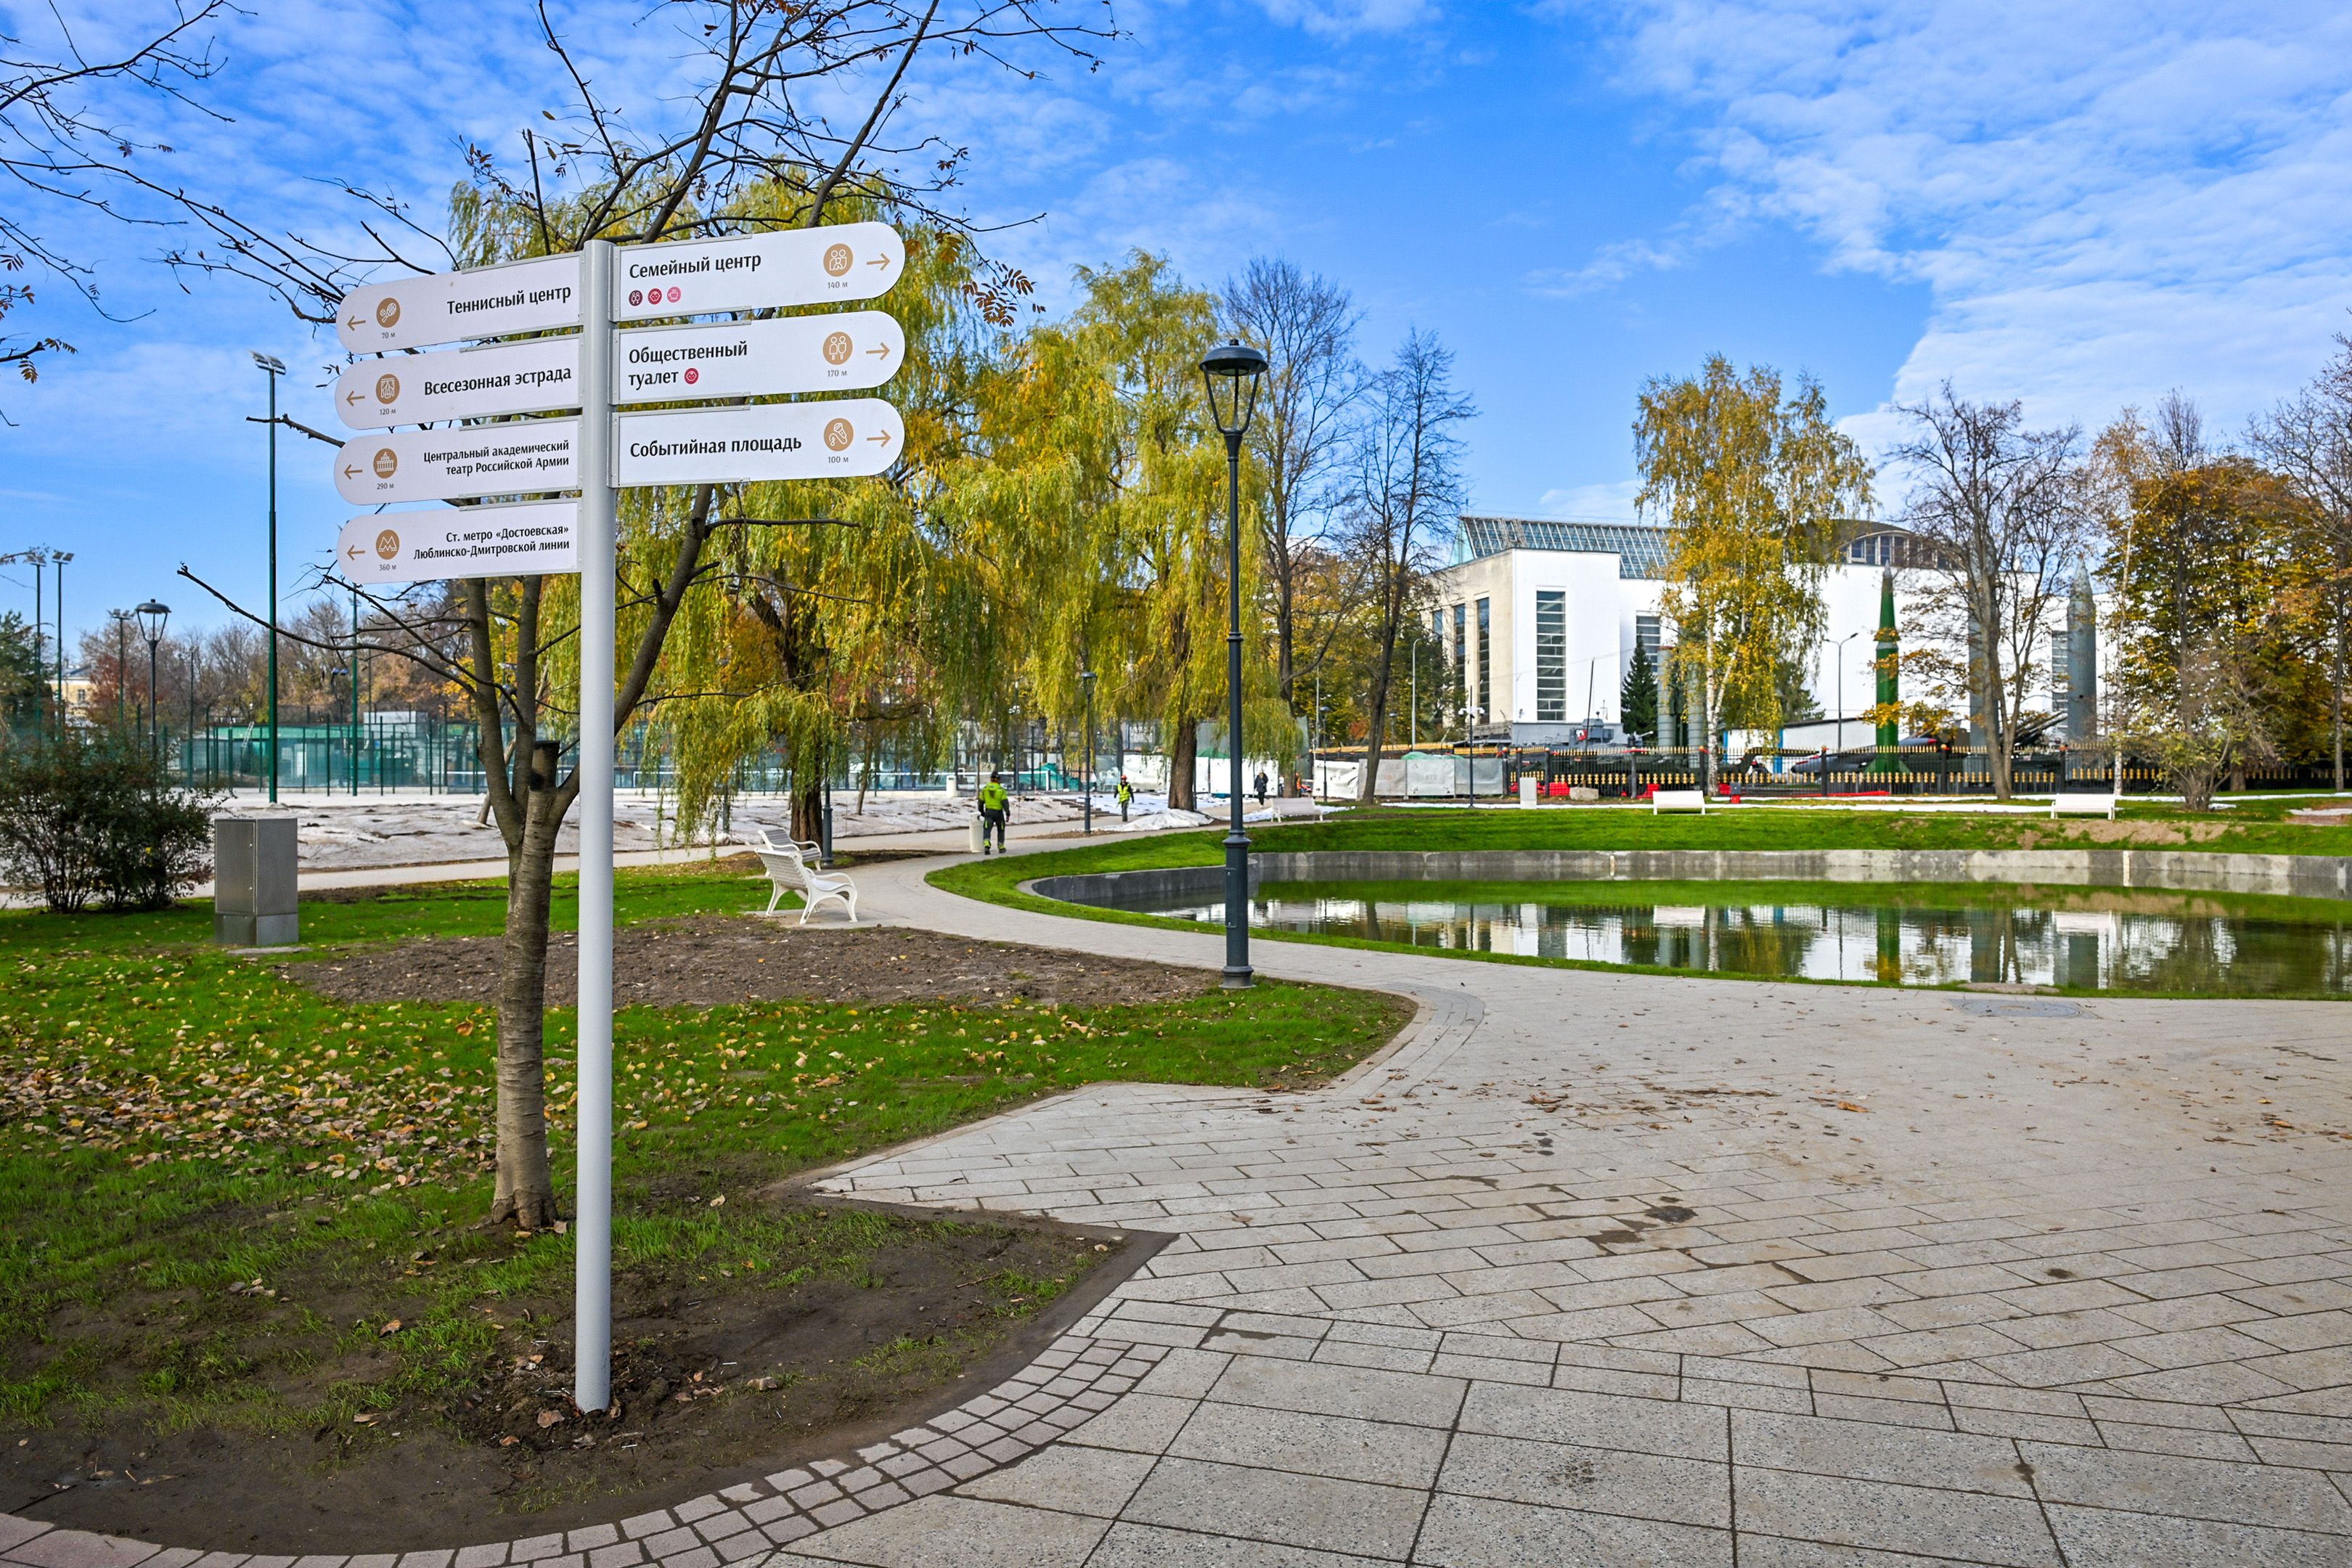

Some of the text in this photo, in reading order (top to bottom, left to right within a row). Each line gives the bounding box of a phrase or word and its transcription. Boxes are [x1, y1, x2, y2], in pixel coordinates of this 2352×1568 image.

[630, 256, 761, 278] Семейный центр
[447, 287, 571, 314] Теннисный центр
[629, 340, 747, 364] Общественный
[425, 368, 571, 395] Всесезонная эстрада
[629, 372, 679, 391] туалет
[424, 440, 568, 464] Центральный академический
[631, 438, 801, 457] Событийная площадь
[446, 457, 568, 476] театр Российской Армии
[446, 526, 568, 543] Ст. метро «Достоевская»
[414, 541, 569, 559] Люблинско-Дмитровской линии
